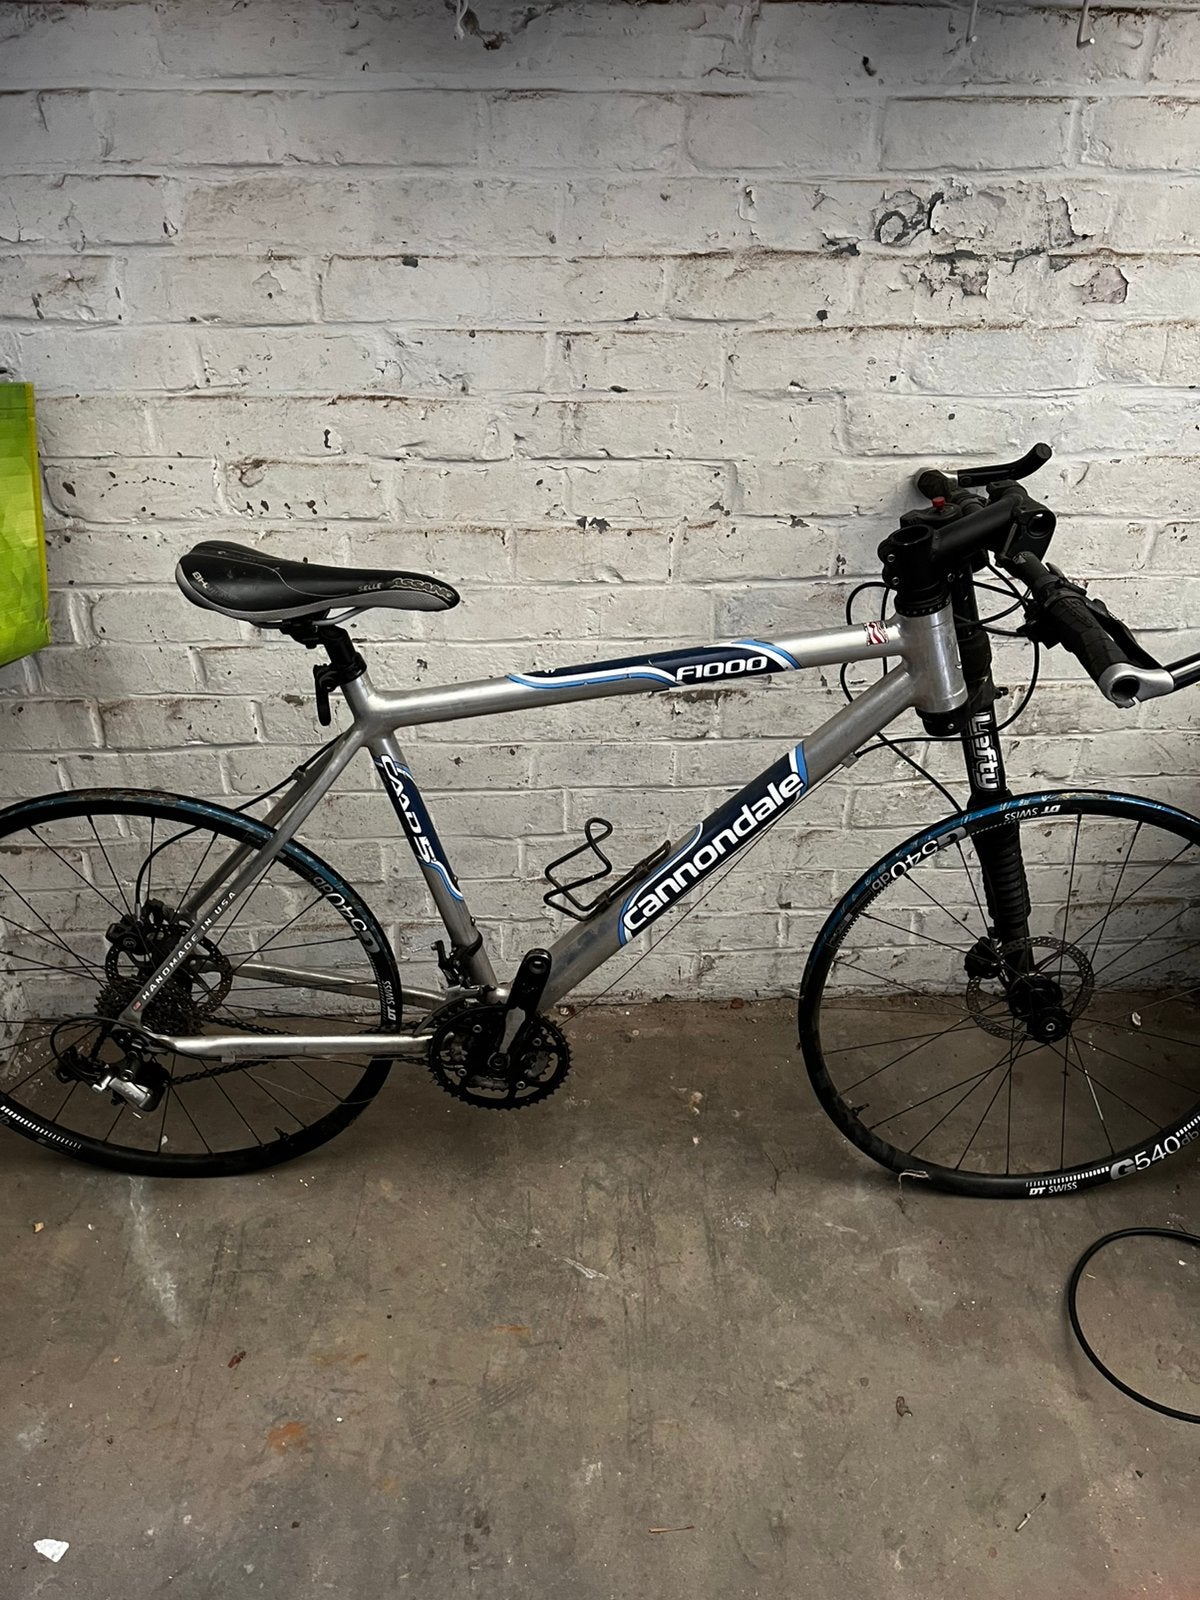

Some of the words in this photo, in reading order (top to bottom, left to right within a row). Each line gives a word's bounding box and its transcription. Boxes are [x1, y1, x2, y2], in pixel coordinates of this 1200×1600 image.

[357, 582, 383, 592] SELLE
[676, 655, 768, 682] F1000
[1003, 807, 1039, 822] SWISS
[1040, 803, 1061, 815] DT
[623, 772, 804, 931] cannondale
[142, 934, 199, 1001] HANDMADE
[201, 917, 213, 931] IN
[214, 891, 236, 915] USA
[1029, 1186, 1047, 1196] DT
[1047, 1181, 1078, 1194] SWISS
